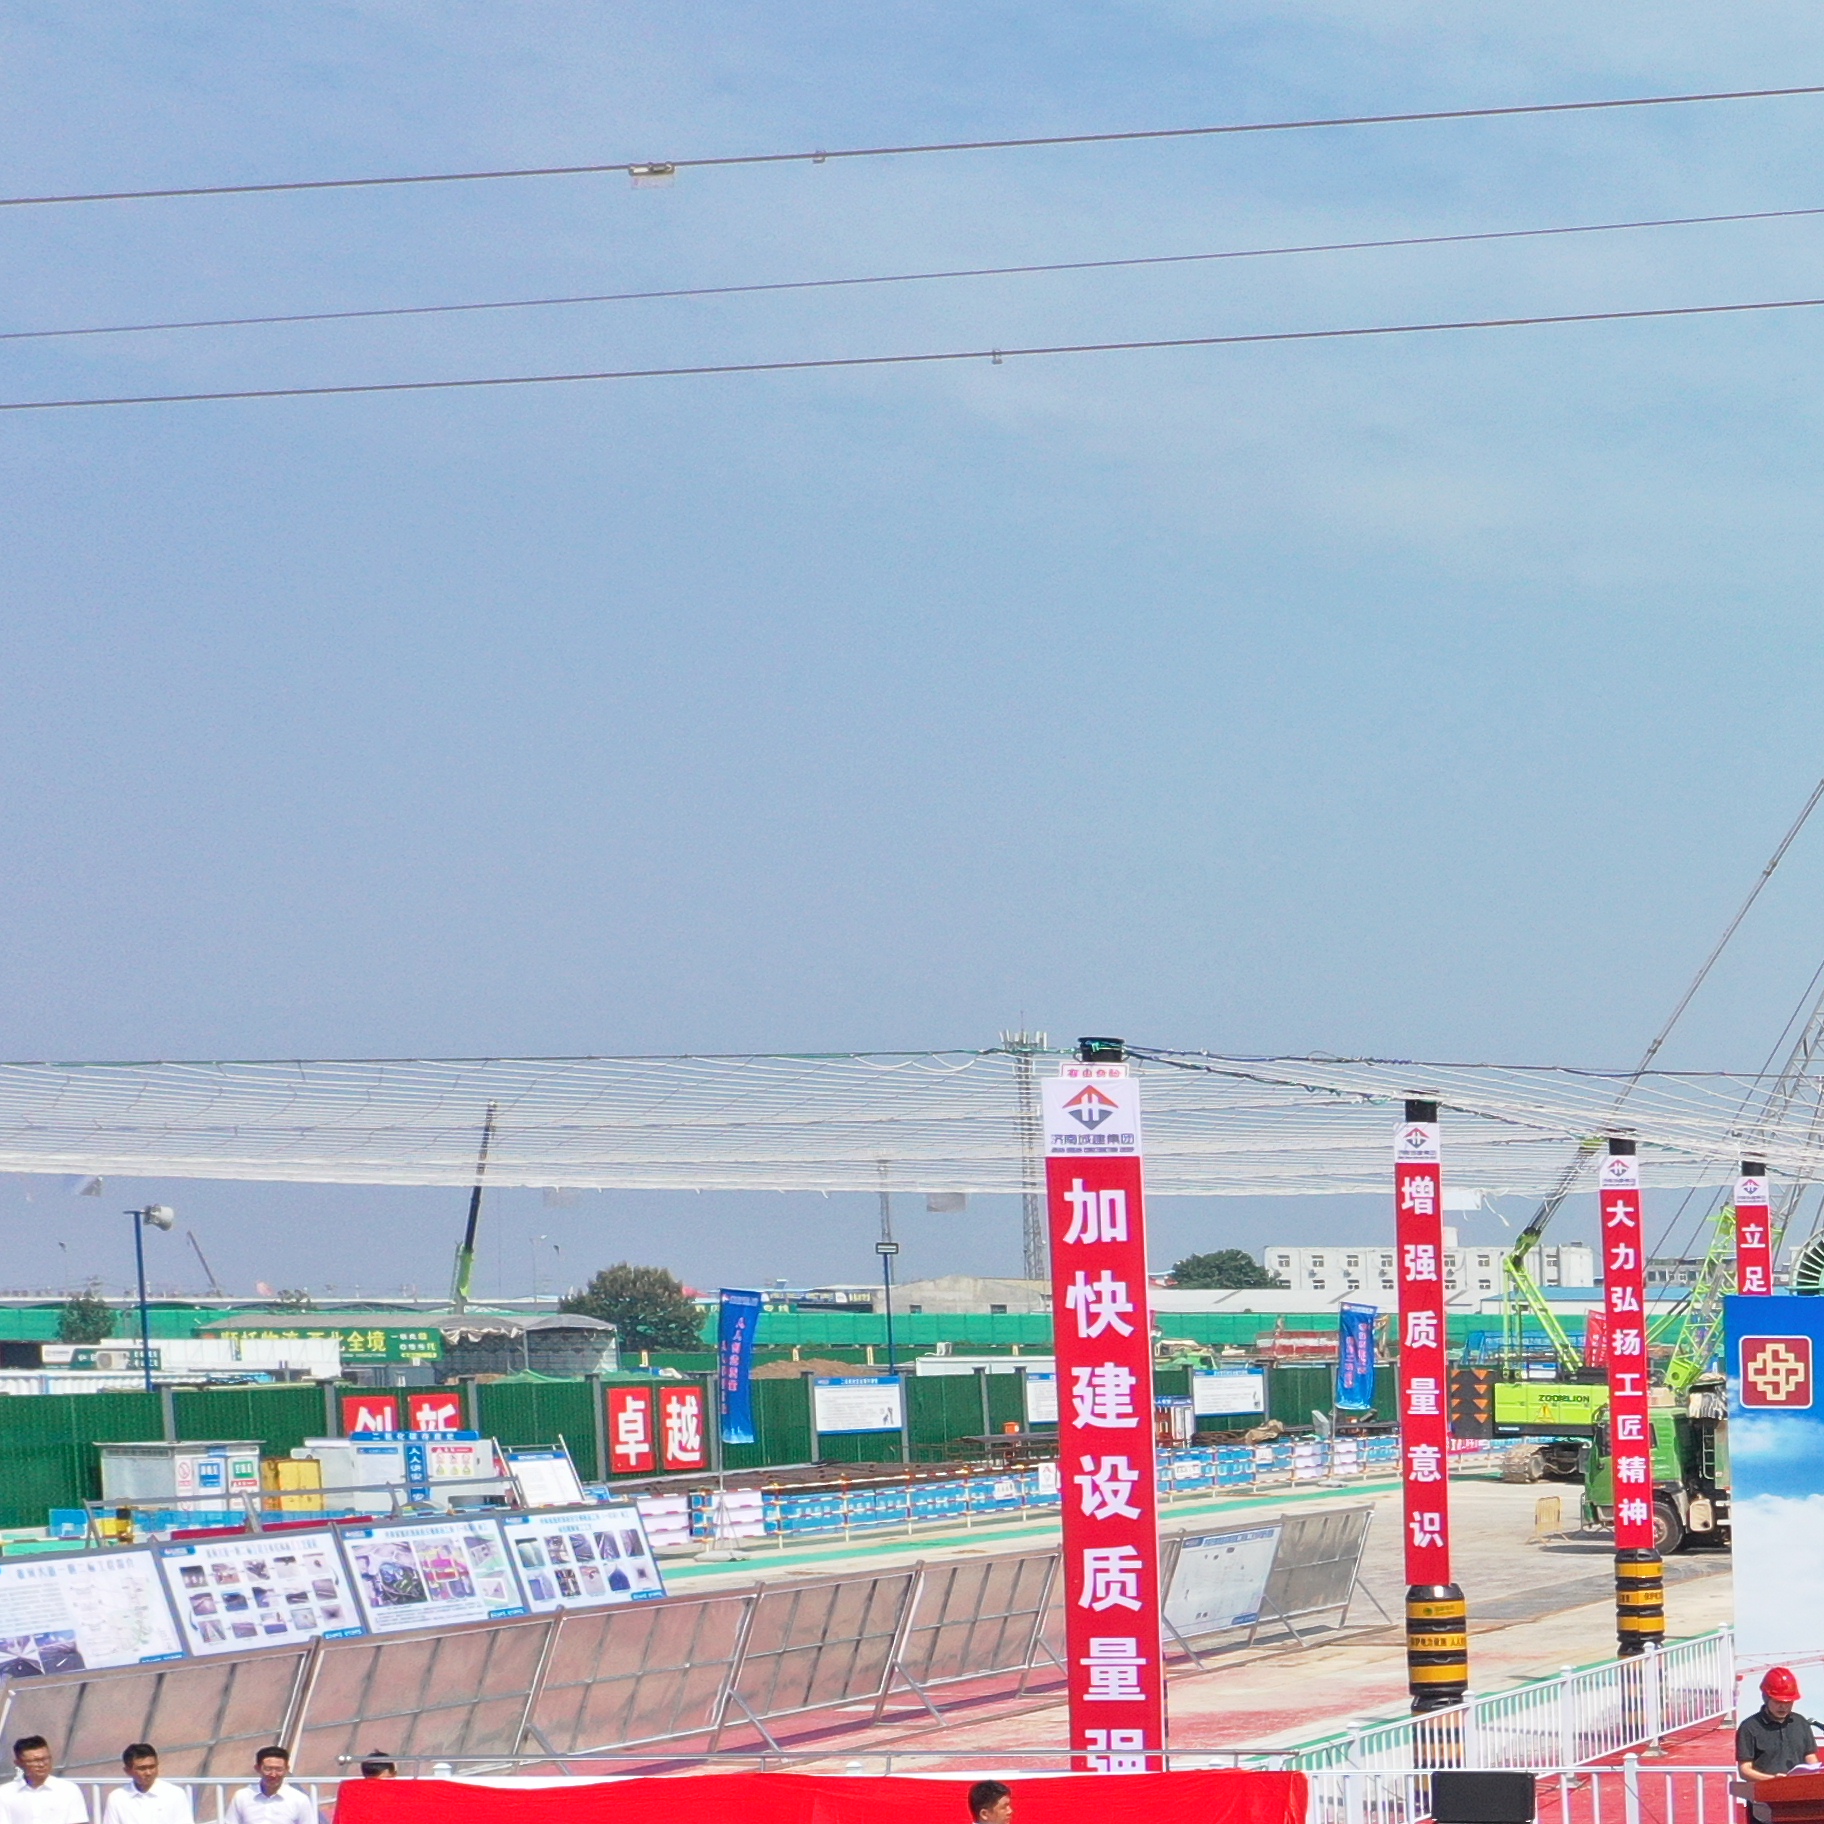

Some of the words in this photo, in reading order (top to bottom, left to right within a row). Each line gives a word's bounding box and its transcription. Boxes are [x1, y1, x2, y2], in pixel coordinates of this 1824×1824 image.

[1051, 1133, 1135, 1145] 济南城建集团
[615, 1395, 700, 1466] 卓越
[1402, 1175, 1444, 1548] 增强质量意识
[1607, 1200, 1648, 1527] 大力弘扬工匠精神
